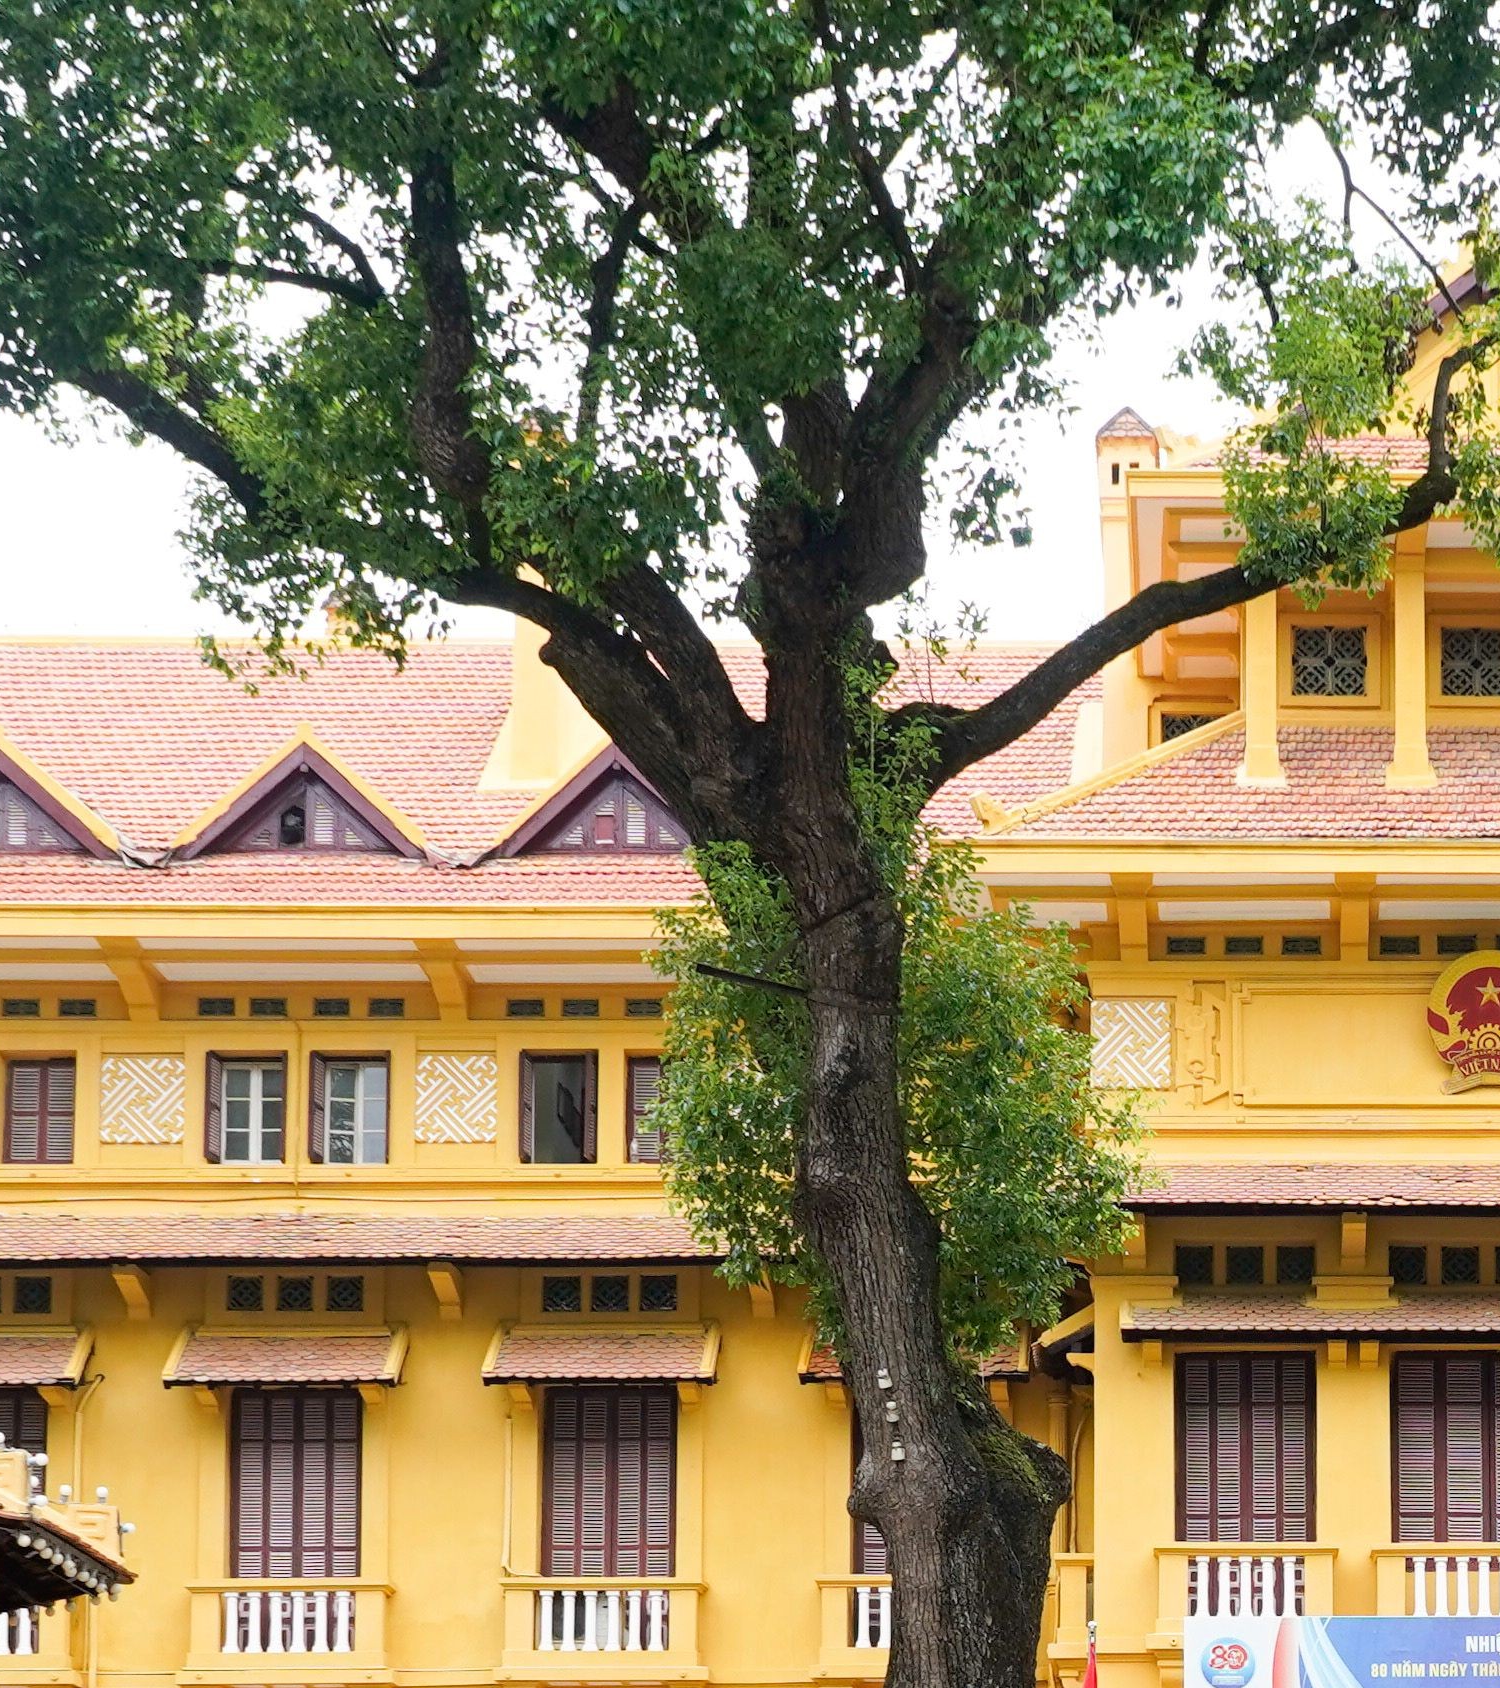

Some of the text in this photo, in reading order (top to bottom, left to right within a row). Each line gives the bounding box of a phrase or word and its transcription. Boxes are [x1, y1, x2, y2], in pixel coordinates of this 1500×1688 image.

[1370, 1663, 1388, 1677] 80
[1391, 1660, 1426, 1678] NĂM
[1429, 1660, 1468, 1678] NGÀY
